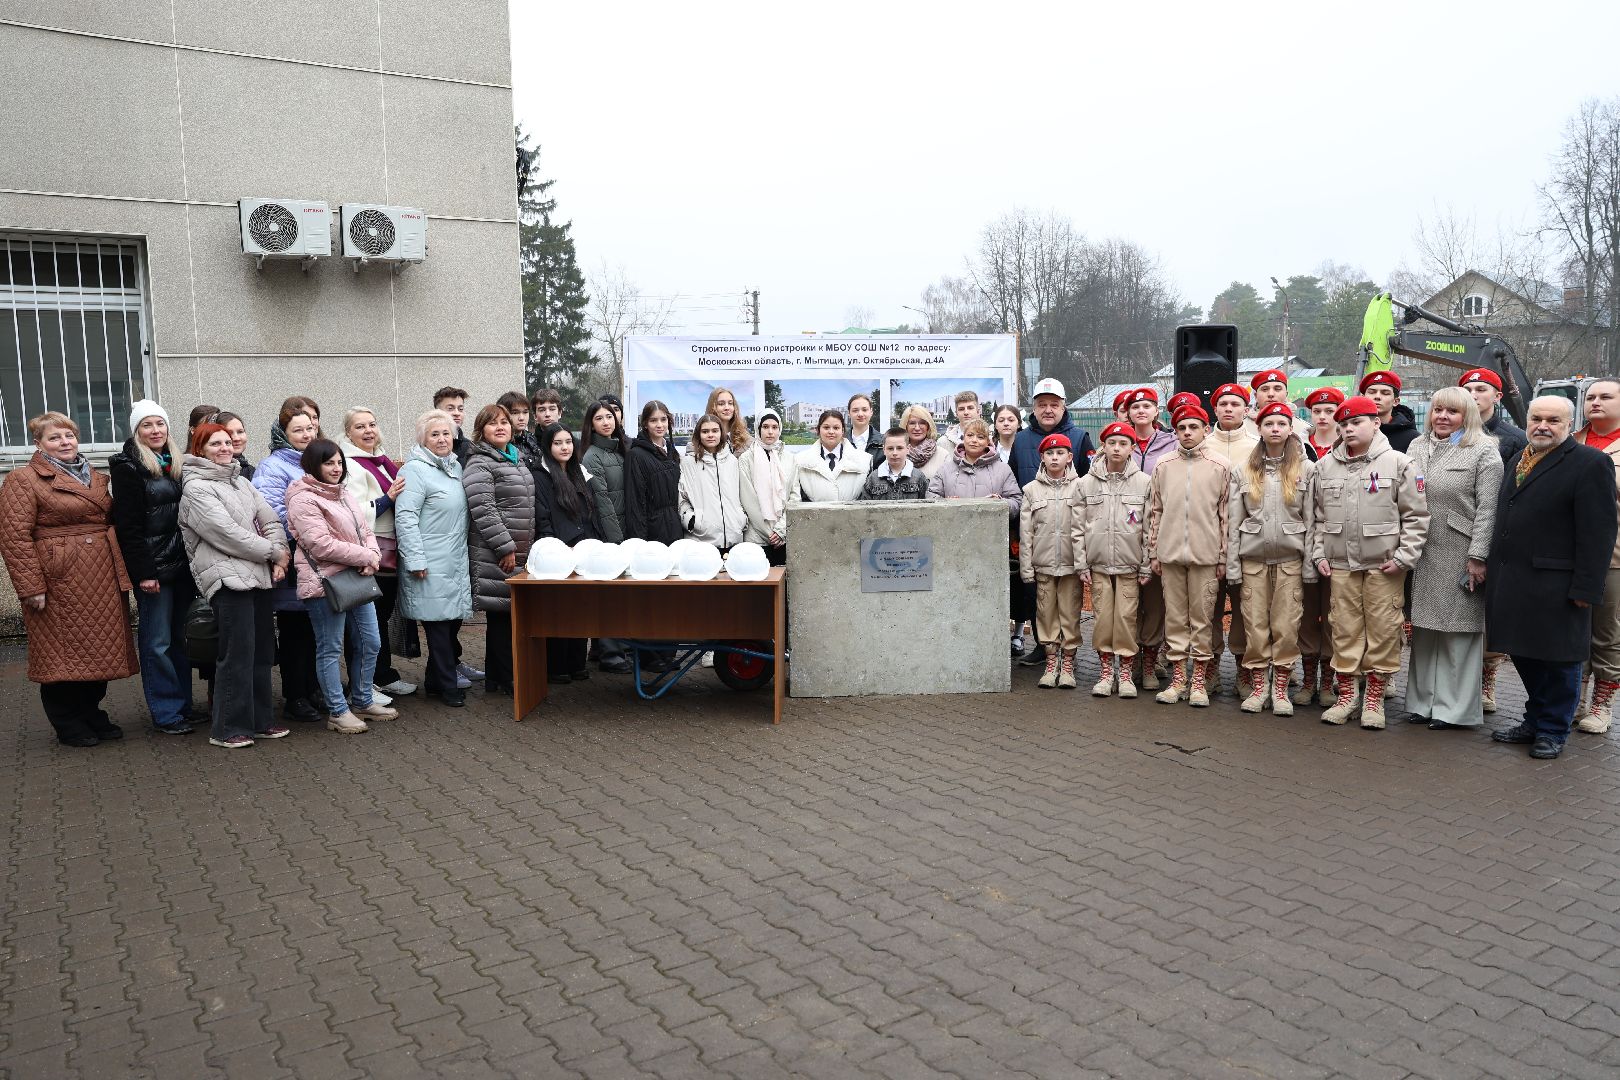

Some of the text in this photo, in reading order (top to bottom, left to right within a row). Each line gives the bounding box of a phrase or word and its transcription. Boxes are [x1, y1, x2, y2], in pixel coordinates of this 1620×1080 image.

[691, 344, 761, 354] Строительство
[763, 344, 816, 354] пристройки
[825, 343, 853, 352] МБОУ
[854, 343, 877, 352] СОШ
[879, 343, 900, 352] №12
[917, 345, 951, 353] адресу:
[1425, 340, 1465, 354] ZOOMLION
[698, 357, 752, 366] Московская
[754, 357, 794, 366] область,
[804, 356, 845, 366] Мытищи,
[847, 358, 861, 366] ул.
[863, 356, 923, 366] Октябрьская,
[924, 356, 945, 365] д.4А
